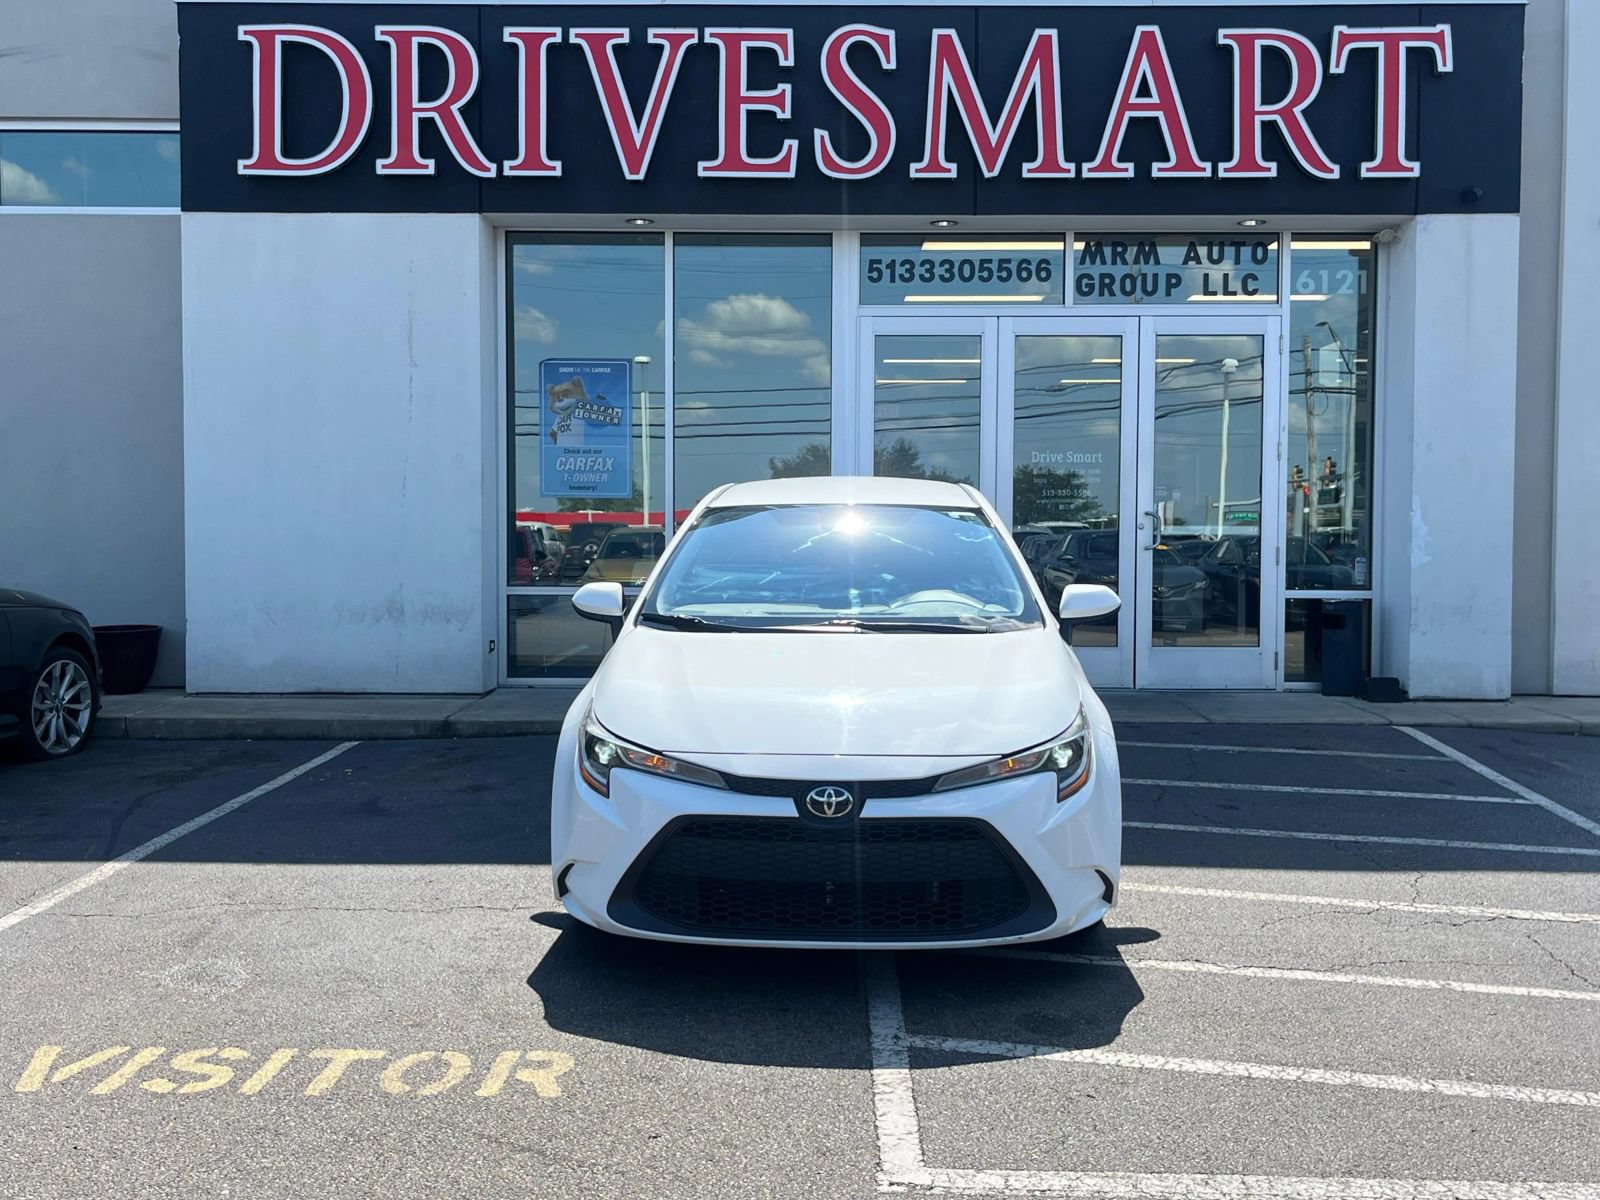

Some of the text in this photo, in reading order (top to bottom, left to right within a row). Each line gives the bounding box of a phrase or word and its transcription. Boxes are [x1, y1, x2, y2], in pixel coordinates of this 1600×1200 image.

[1078, 240, 1269, 266] MRM AUTO
[867, 258, 1052, 283] 5133305566
[1075, 272, 1260, 297] GROUP LLC
[1295, 269, 1368, 295] 6121
[577, 402, 622, 417] CARFAX
[583, 412, 619, 424] OWNER
[556, 457, 615, 471] CARFAX
[1031, 451, 1103, 463] Drive Smart
[563, 473, 608, 482] 1-OWNER
[14, 1044, 576, 1098] VISITOR
